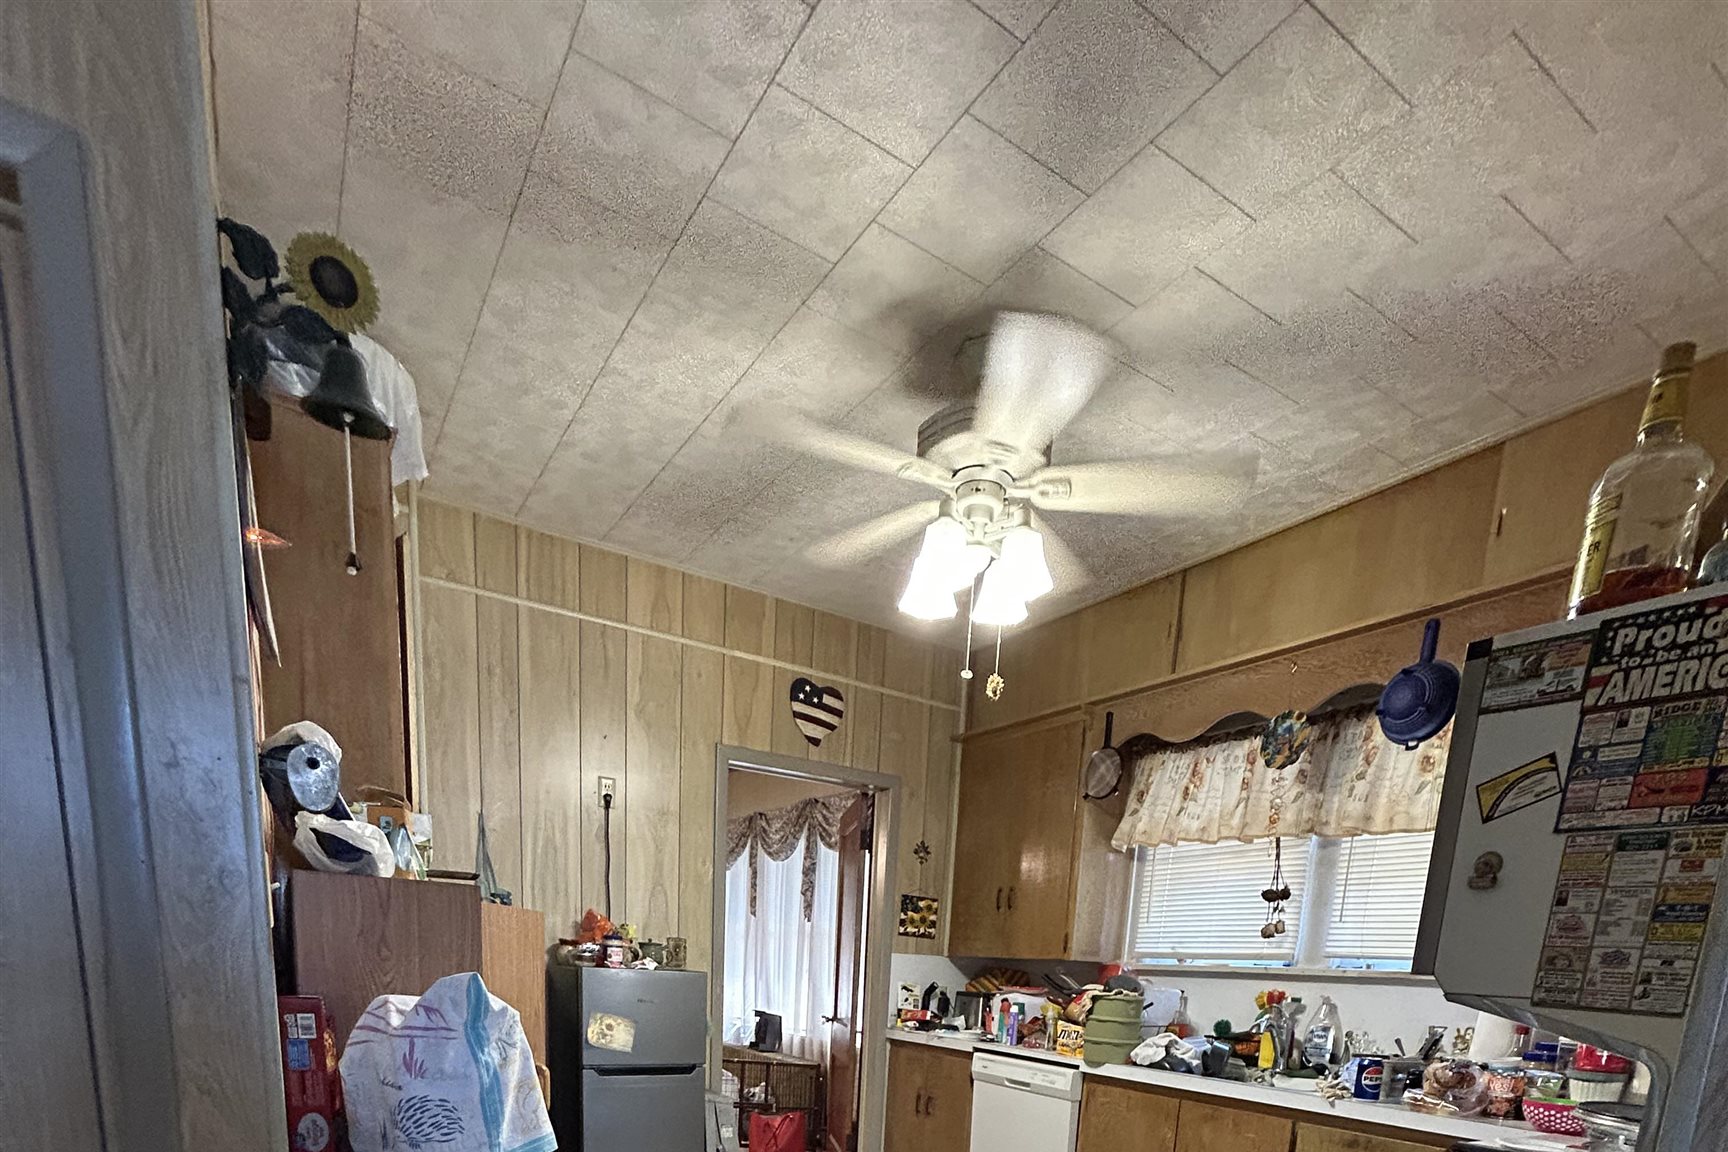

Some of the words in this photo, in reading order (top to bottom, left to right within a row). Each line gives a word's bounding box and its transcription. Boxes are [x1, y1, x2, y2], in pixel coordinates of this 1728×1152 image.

[1621, 656, 1640, 668] to
[1656, 649, 1681, 662] be
[1686, 643, 1716, 657] an
